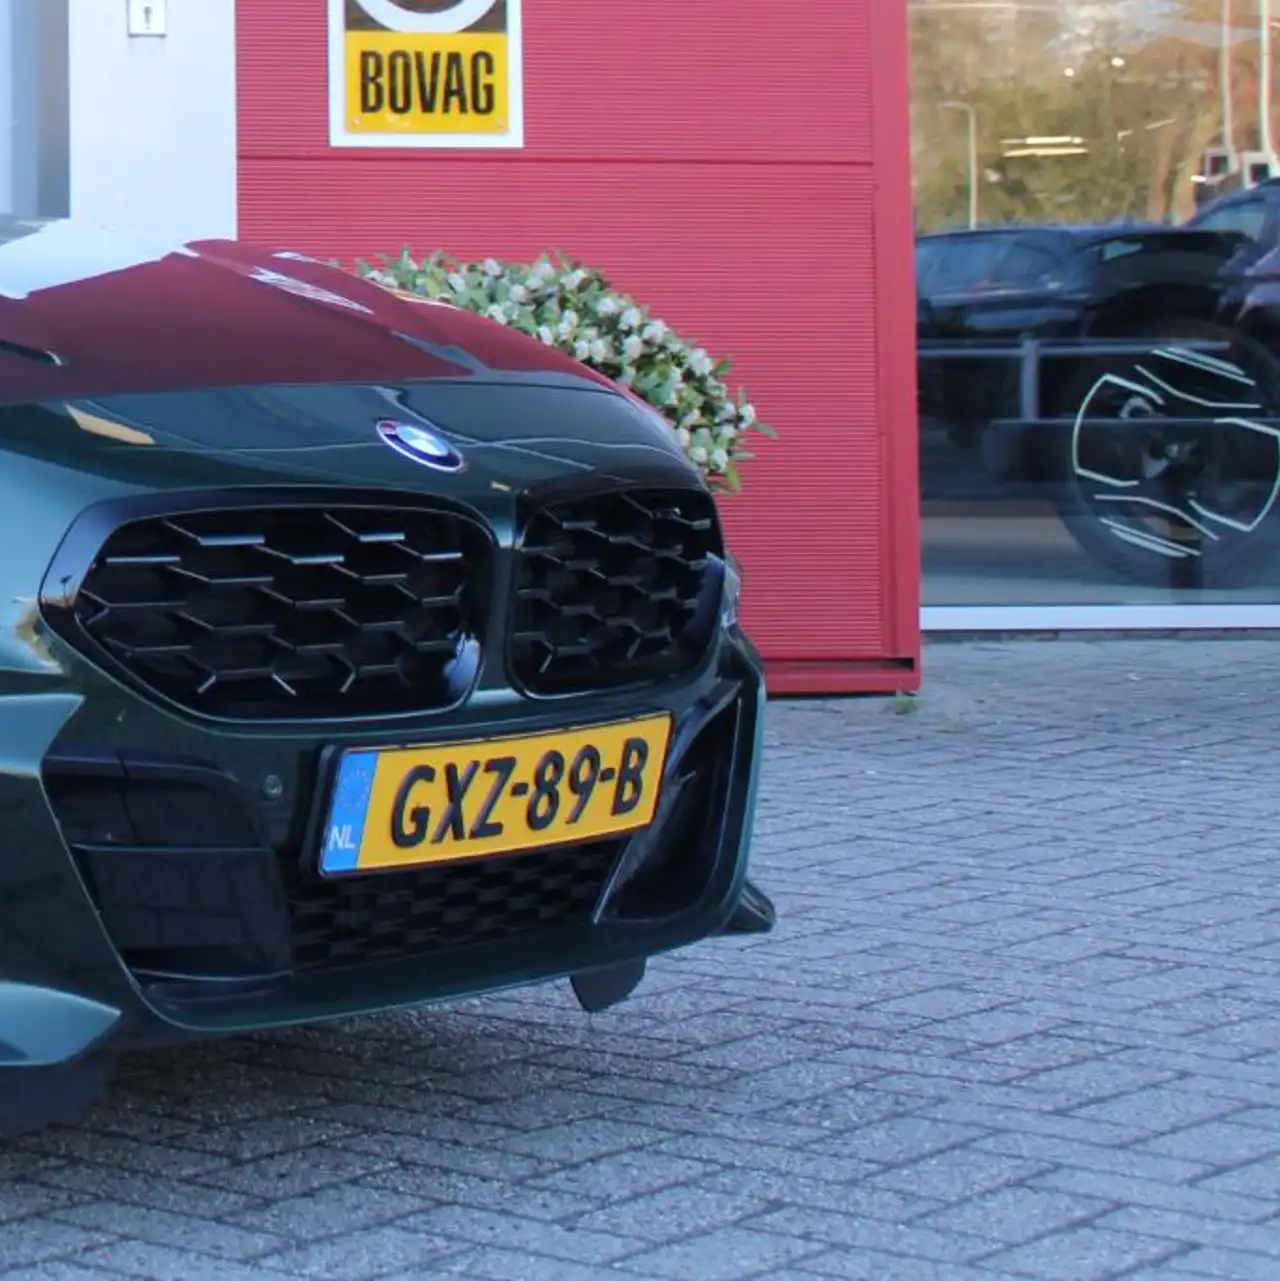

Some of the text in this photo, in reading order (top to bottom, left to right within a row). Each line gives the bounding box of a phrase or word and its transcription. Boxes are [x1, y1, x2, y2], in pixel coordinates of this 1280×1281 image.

[360, 51, 494, 115] BOVAG
[391, 737, 649, 848] GXZ-89-B
[329, 825, 355, 849] NL
